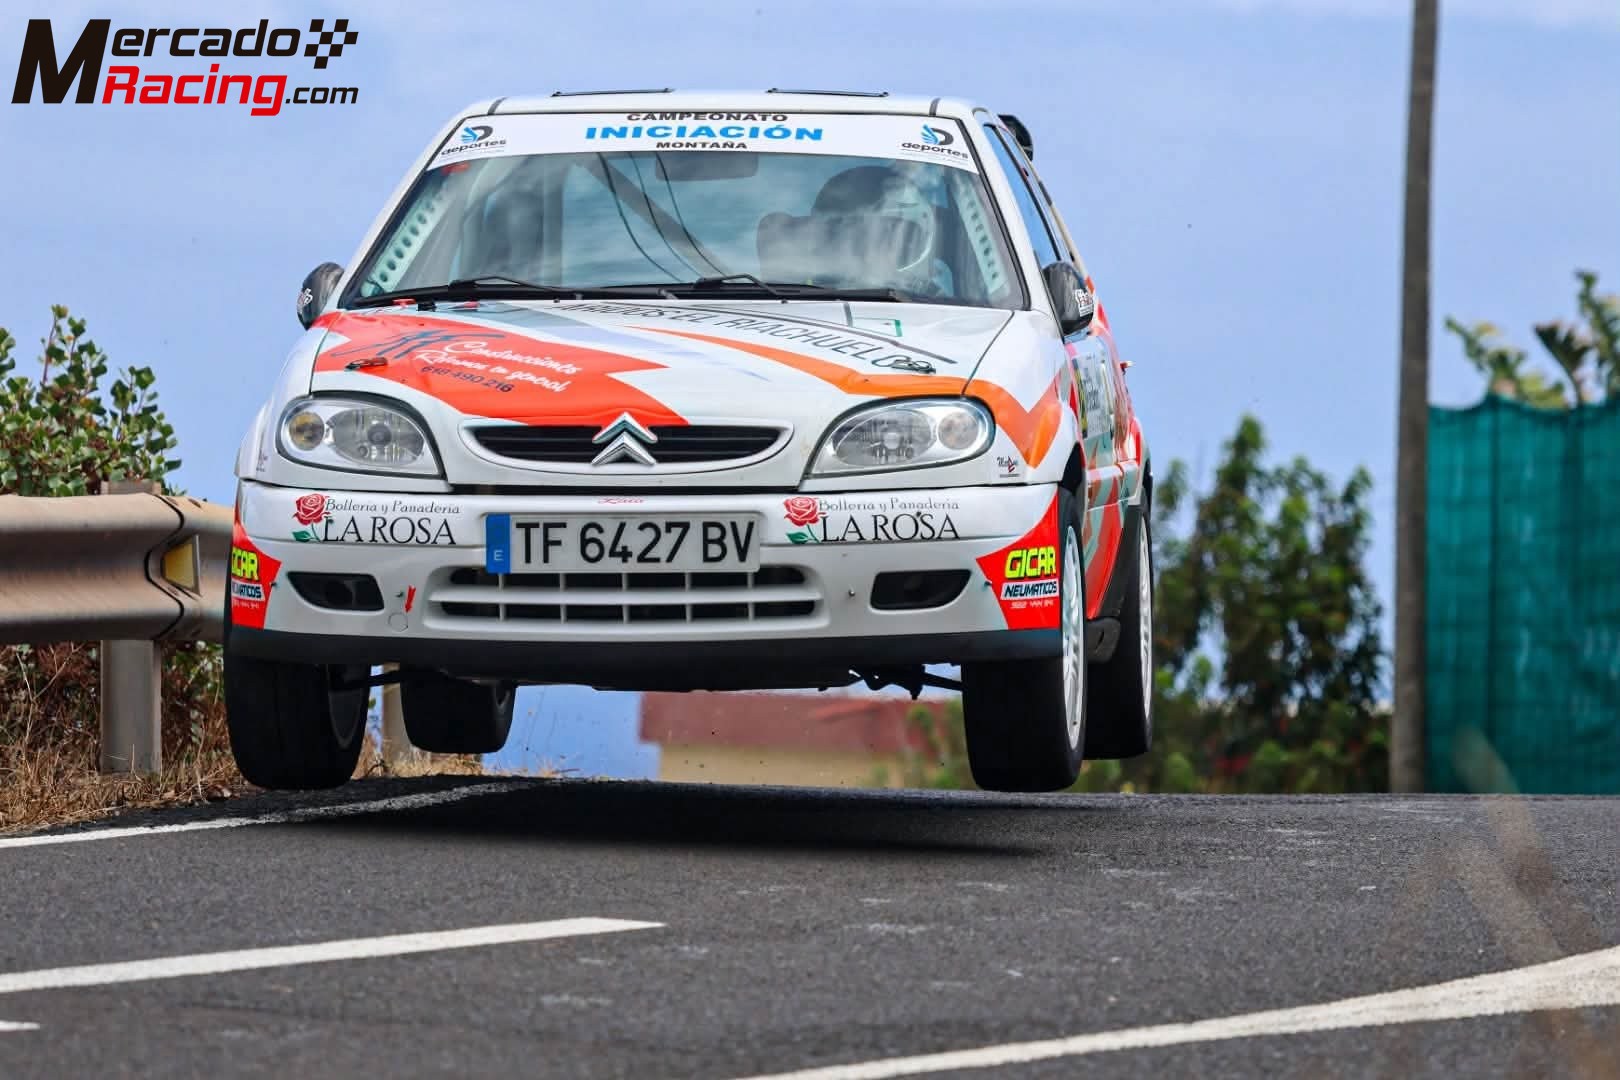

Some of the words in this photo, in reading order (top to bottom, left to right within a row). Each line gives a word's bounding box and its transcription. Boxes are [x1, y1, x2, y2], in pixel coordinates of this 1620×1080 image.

[627, 112, 788, 121] CAMPEONATO
[585, 125, 823, 141] INICIACIÓN
[441, 139, 506, 156] deportes
[656, 141, 748, 149] MONTAÑA
[902, 142, 969, 159] deportes
[484, 380, 515, 392] 216
[381, 504, 389, 514] y
[879, 503, 887, 512] y
[323, 516, 363, 542] LA
[370, 517, 456, 545] ROSA
[821, 515, 867, 542] LA
[871, 513, 960, 541] ROSA
[516, 522, 567, 563] TF
[580, 522, 690, 563] 6427
[703, 521, 754, 563] BV
[493, 549, 503, 561] E
[1005, 546, 1057, 578] GICAR
[1004, 581, 1057, 597] NEUMATICOS
